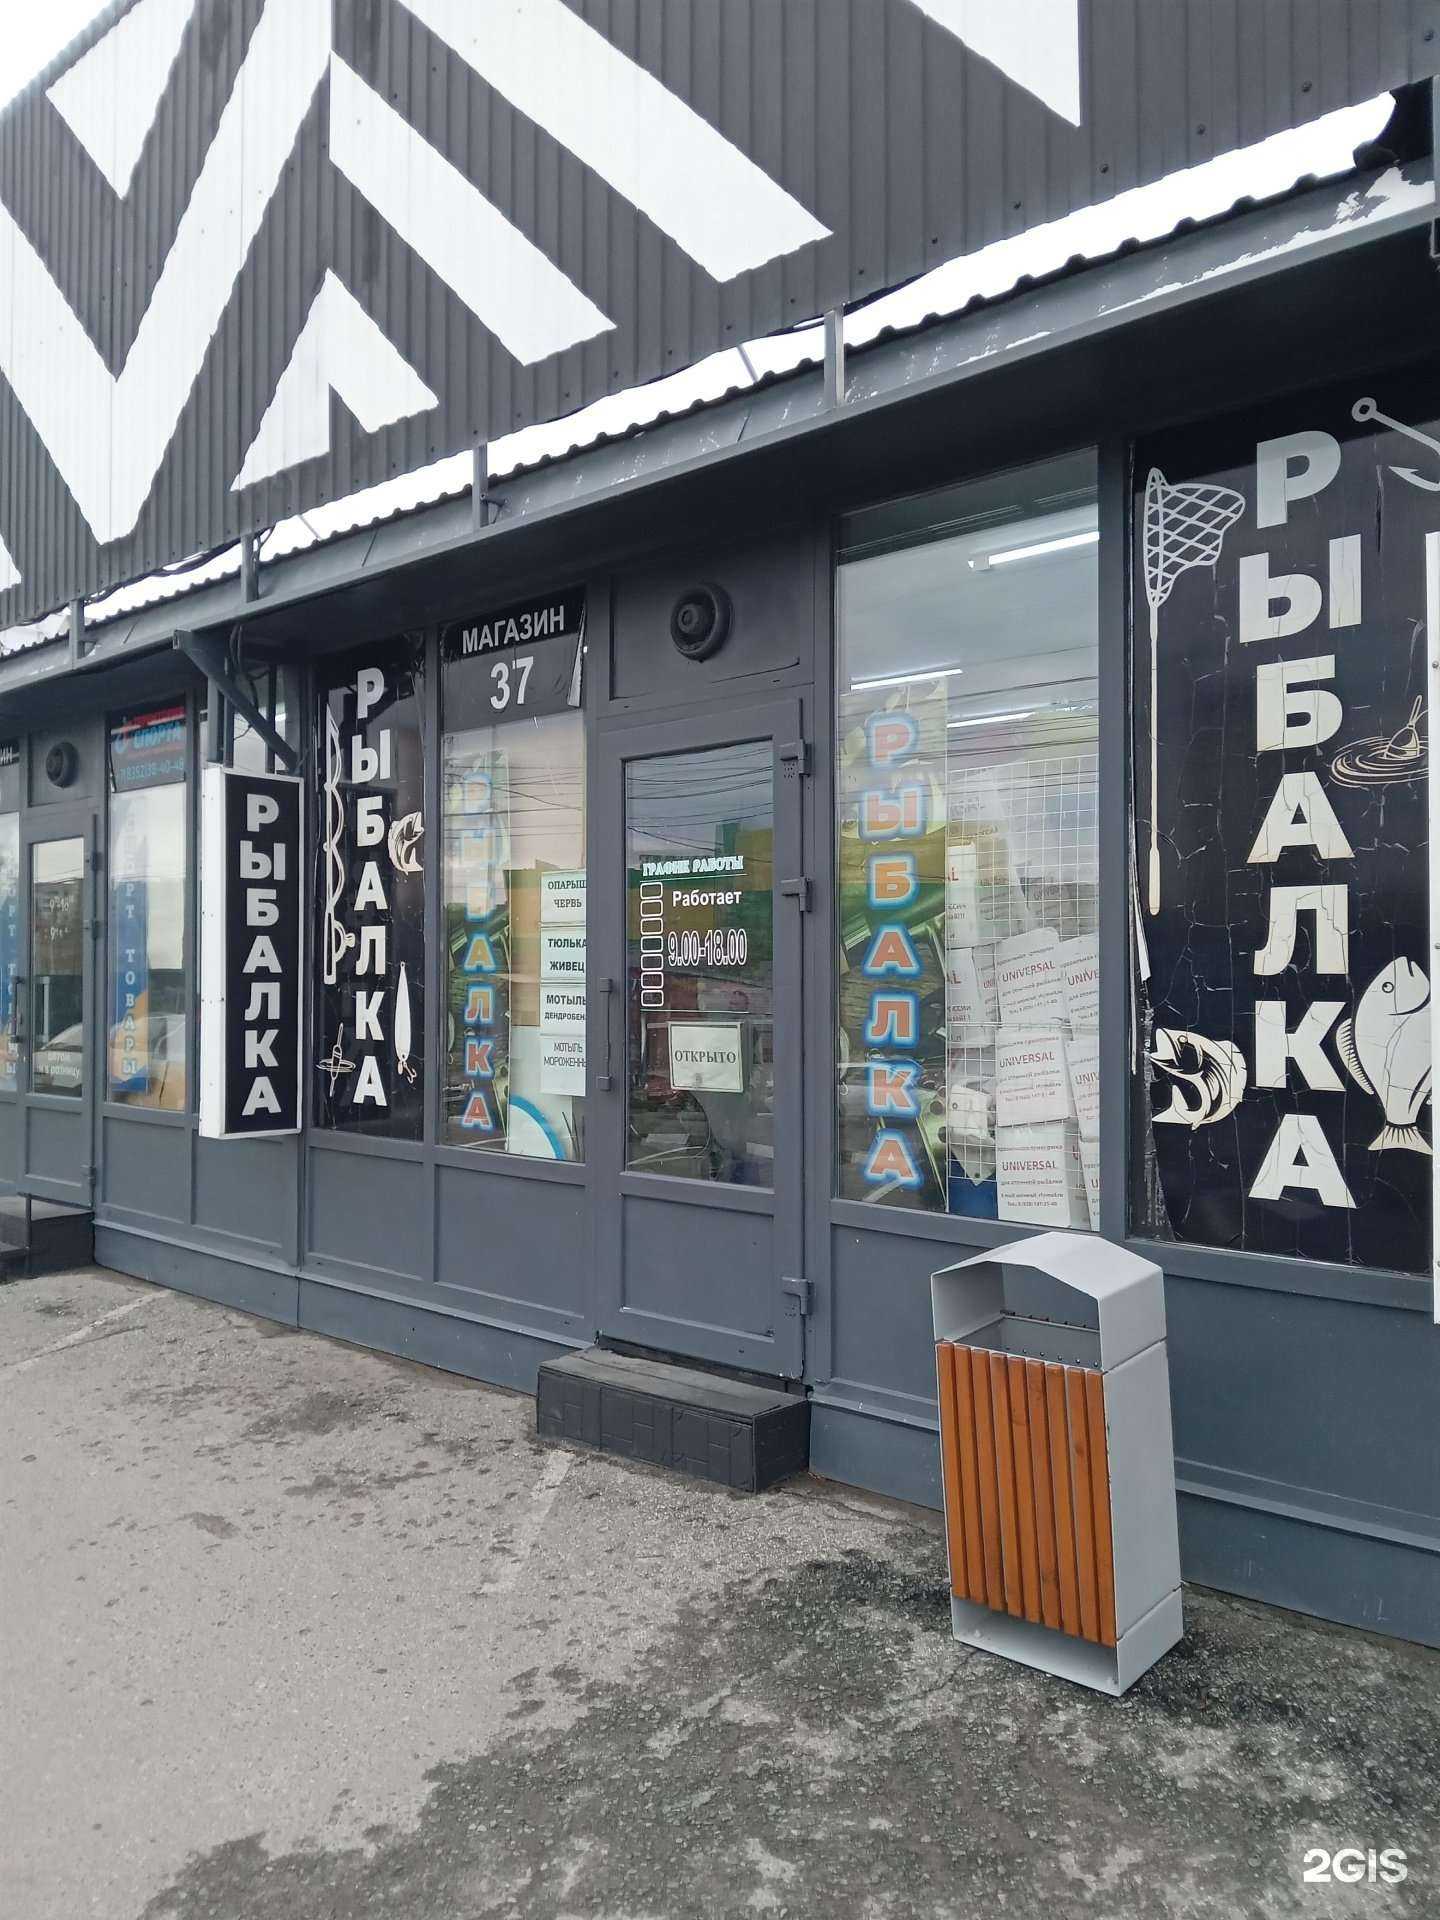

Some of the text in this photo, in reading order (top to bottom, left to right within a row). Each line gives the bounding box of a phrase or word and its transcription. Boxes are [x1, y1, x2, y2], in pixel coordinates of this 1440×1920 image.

[462, 605, 565, 654] МАГАЗИН
[490, 656, 534, 709] 37
[1239, 429, 1363, 1209] РЫБАЛКА
[642, 855, 744, 877] ГРАФИК РАБОТЫ
[351, 667, 391, 1107] РЫБАЛКА
[672, 889, 742, 907] Работает
[553, 898, 582, 908] ЧЕРВЬ
[239, 793, 286, 1116] РЫБАЛКА
[667, 928, 748, 967] 9.00-18.00
[863, 720, 923, 1183] РЫБАЛКА
[550, 961, 585, 973] ЖИВЕЦ
[1002, 960, 1056, 983] UNIVERSAL
[122, 949, 137, 1074] ТОВАРЫ
[554, 1042, 583, 1053] МОТЫЛЬ
[674, 1050, 737, 1064] ОТКРЫТО
[1000, 1051, 1055, 1068] UNIVERSAL
[1002, 1160, 1057, 1171] UNIVERSAL
